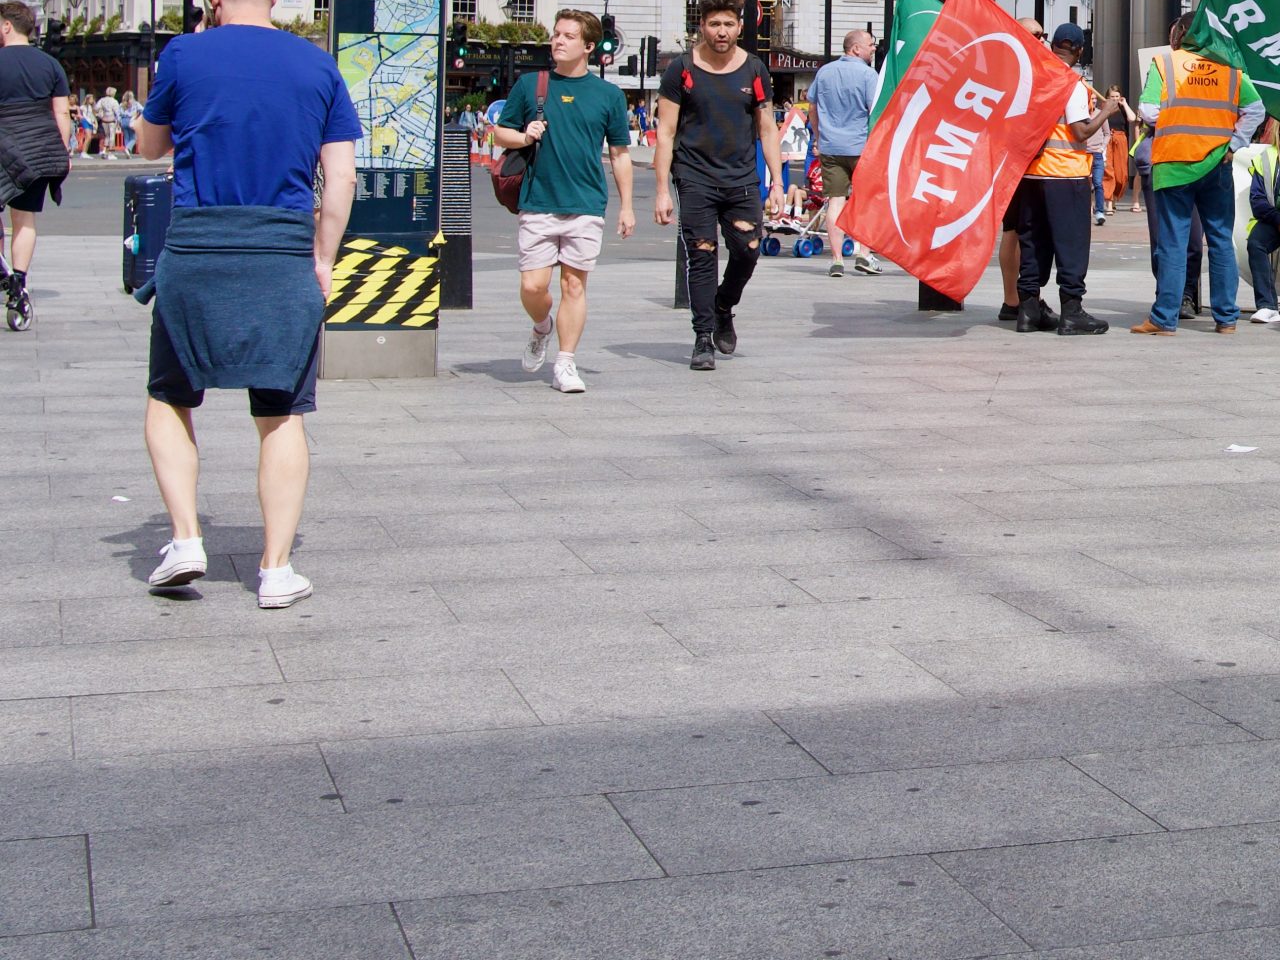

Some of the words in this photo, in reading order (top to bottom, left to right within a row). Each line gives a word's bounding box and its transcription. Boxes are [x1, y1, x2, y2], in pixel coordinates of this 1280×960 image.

[777, 53, 818, 69] PALACE
[1190, 62, 1213, 71] RMT
[1187, 76, 1218, 86] UNION
